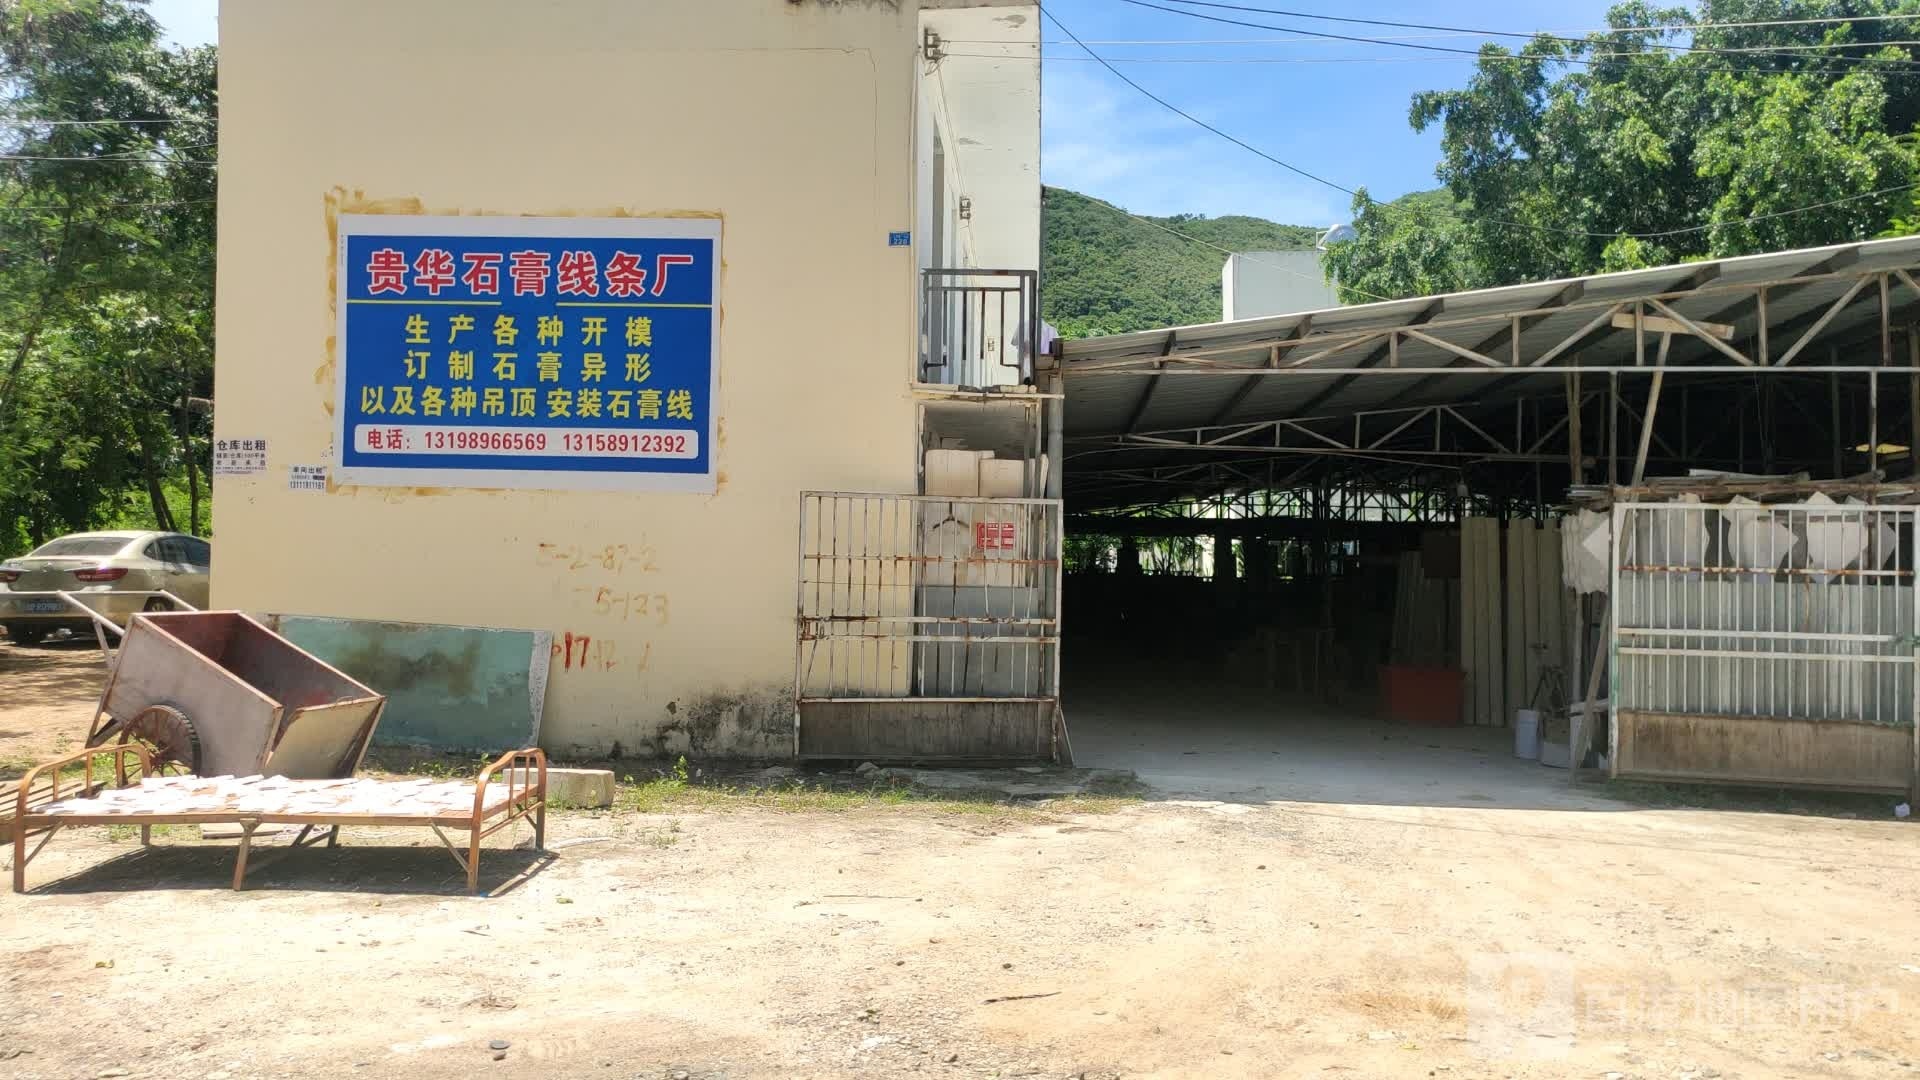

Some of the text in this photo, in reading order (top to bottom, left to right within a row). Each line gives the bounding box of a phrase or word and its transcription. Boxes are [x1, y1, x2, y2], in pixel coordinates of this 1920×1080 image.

[366, 247, 694, 298] 贵华石膏线条厂
[404, 314, 653, 347] 生产各种开模
[404, 350, 652, 382] 订制石膏异形
[217, 440, 266, 451] 仓库出租
[424, 431, 547, 450] 13198966569
[562, 433, 686, 453] 13158912392
